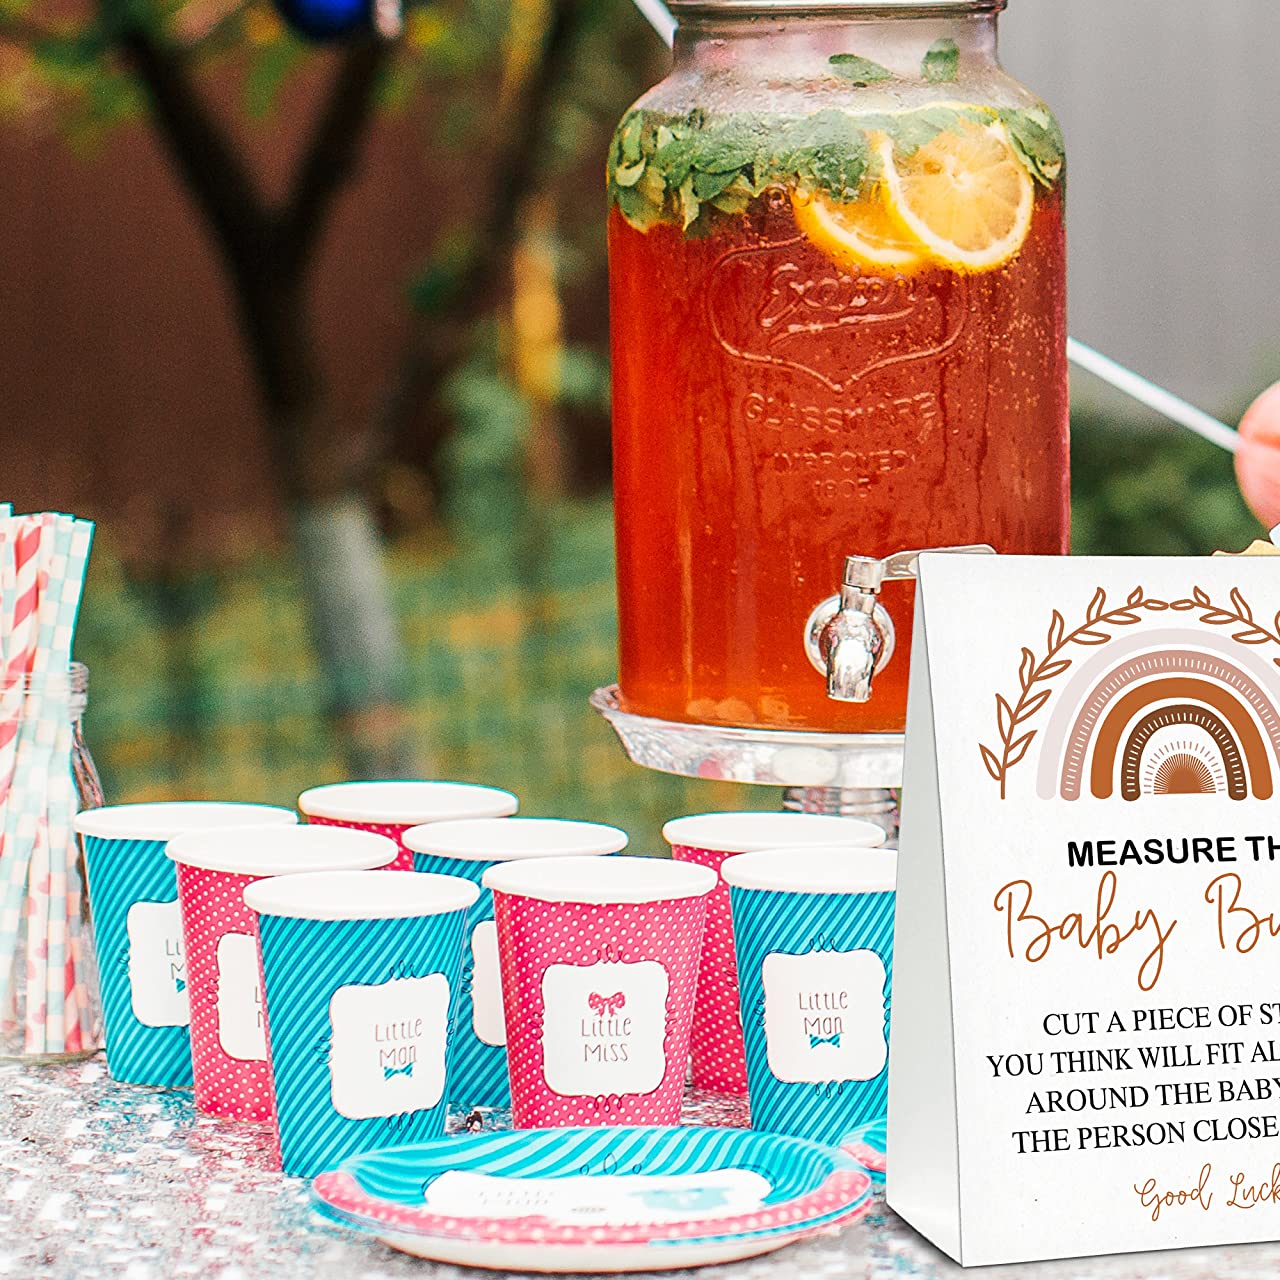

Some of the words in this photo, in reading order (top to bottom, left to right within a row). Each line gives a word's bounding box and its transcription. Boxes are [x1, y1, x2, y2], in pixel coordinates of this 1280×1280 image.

[1067, 836, 1237, 867] MEASURE
[994, 870, 1177, 992] Baby
[803, 1016, 845, 1036] Man
[1043, 1012, 1100, 1036] CUT
[1106, 1011, 1127, 1033] A
[1132, 1006, 1212, 1032] PIECE
[1218, 1004, 1253, 1027] OF
[379, 1045, 418, 1067] Man
[584, 1043, 629, 1062] Miss
[986, 1053, 1044, 1078] YOU
[1050, 1048, 1134, 1074] THINK
[1137, 1045, 1202, 1069] WILL
[1206, 1042, 1245, 1066] FIT
[1025, 1086, 1149, 1114] AROUND
[1155, 1081, 1213, 1106] THE
[1012, 1129, 1071, 1154] THE
[1077, 1121, 1186, 1150] PERSON
[1134, 1163, 1213, 1222] Good
